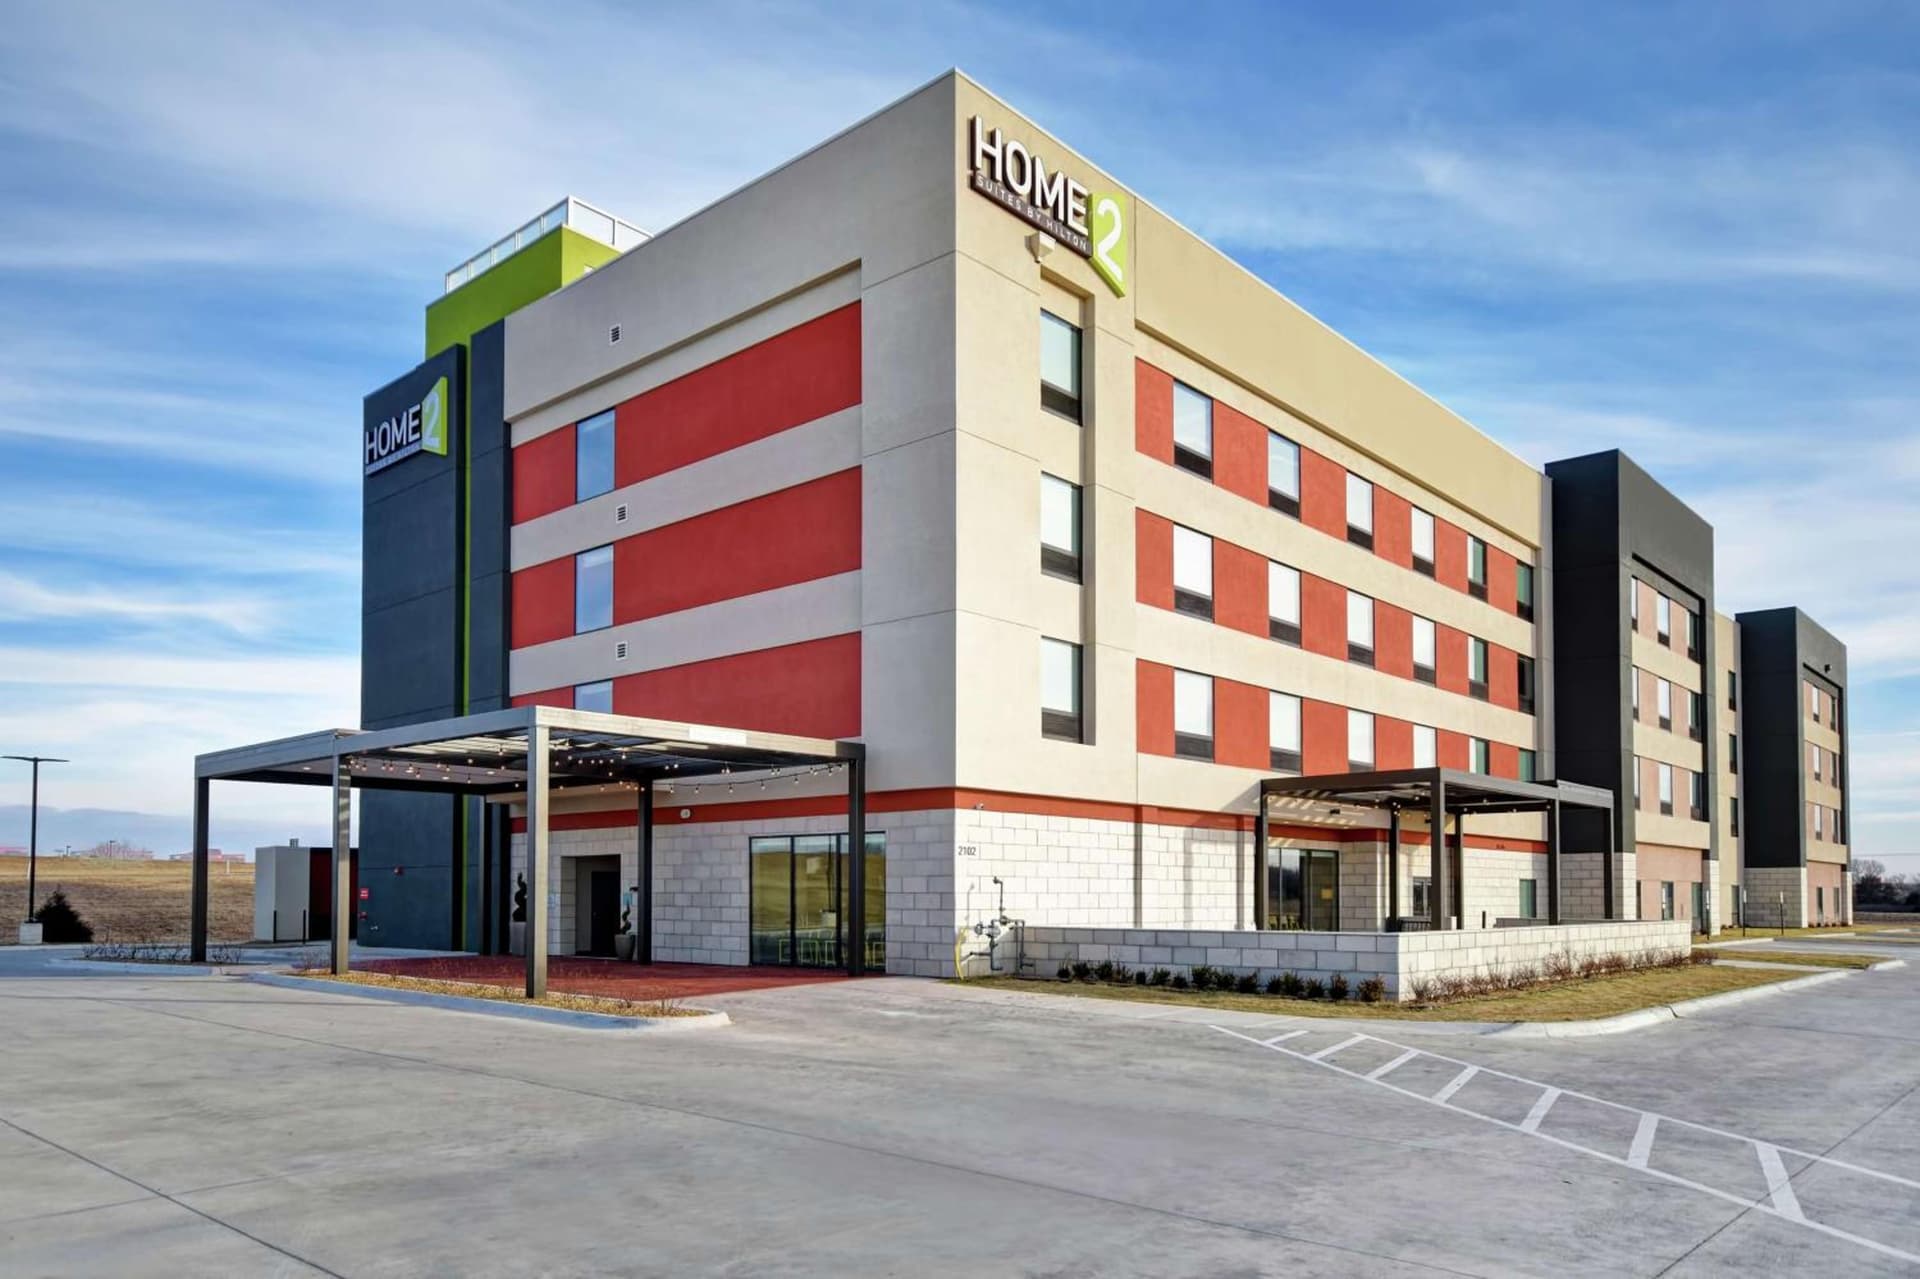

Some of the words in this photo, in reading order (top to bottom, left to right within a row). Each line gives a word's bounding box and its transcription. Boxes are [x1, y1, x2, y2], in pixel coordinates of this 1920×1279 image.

[972, 114, 1088, 236] HOME
[1096, 198, 1123, 281] 2
[976, 175, 1021, 211] SUITES
[1027, 207, 1042, 221] BY
[1045, 220, 1088, 251] HILTON
[365, 404, 421, 464] HOME
[423, 391, 440, 449] 2
[958, 846, 976, 856] 2102
